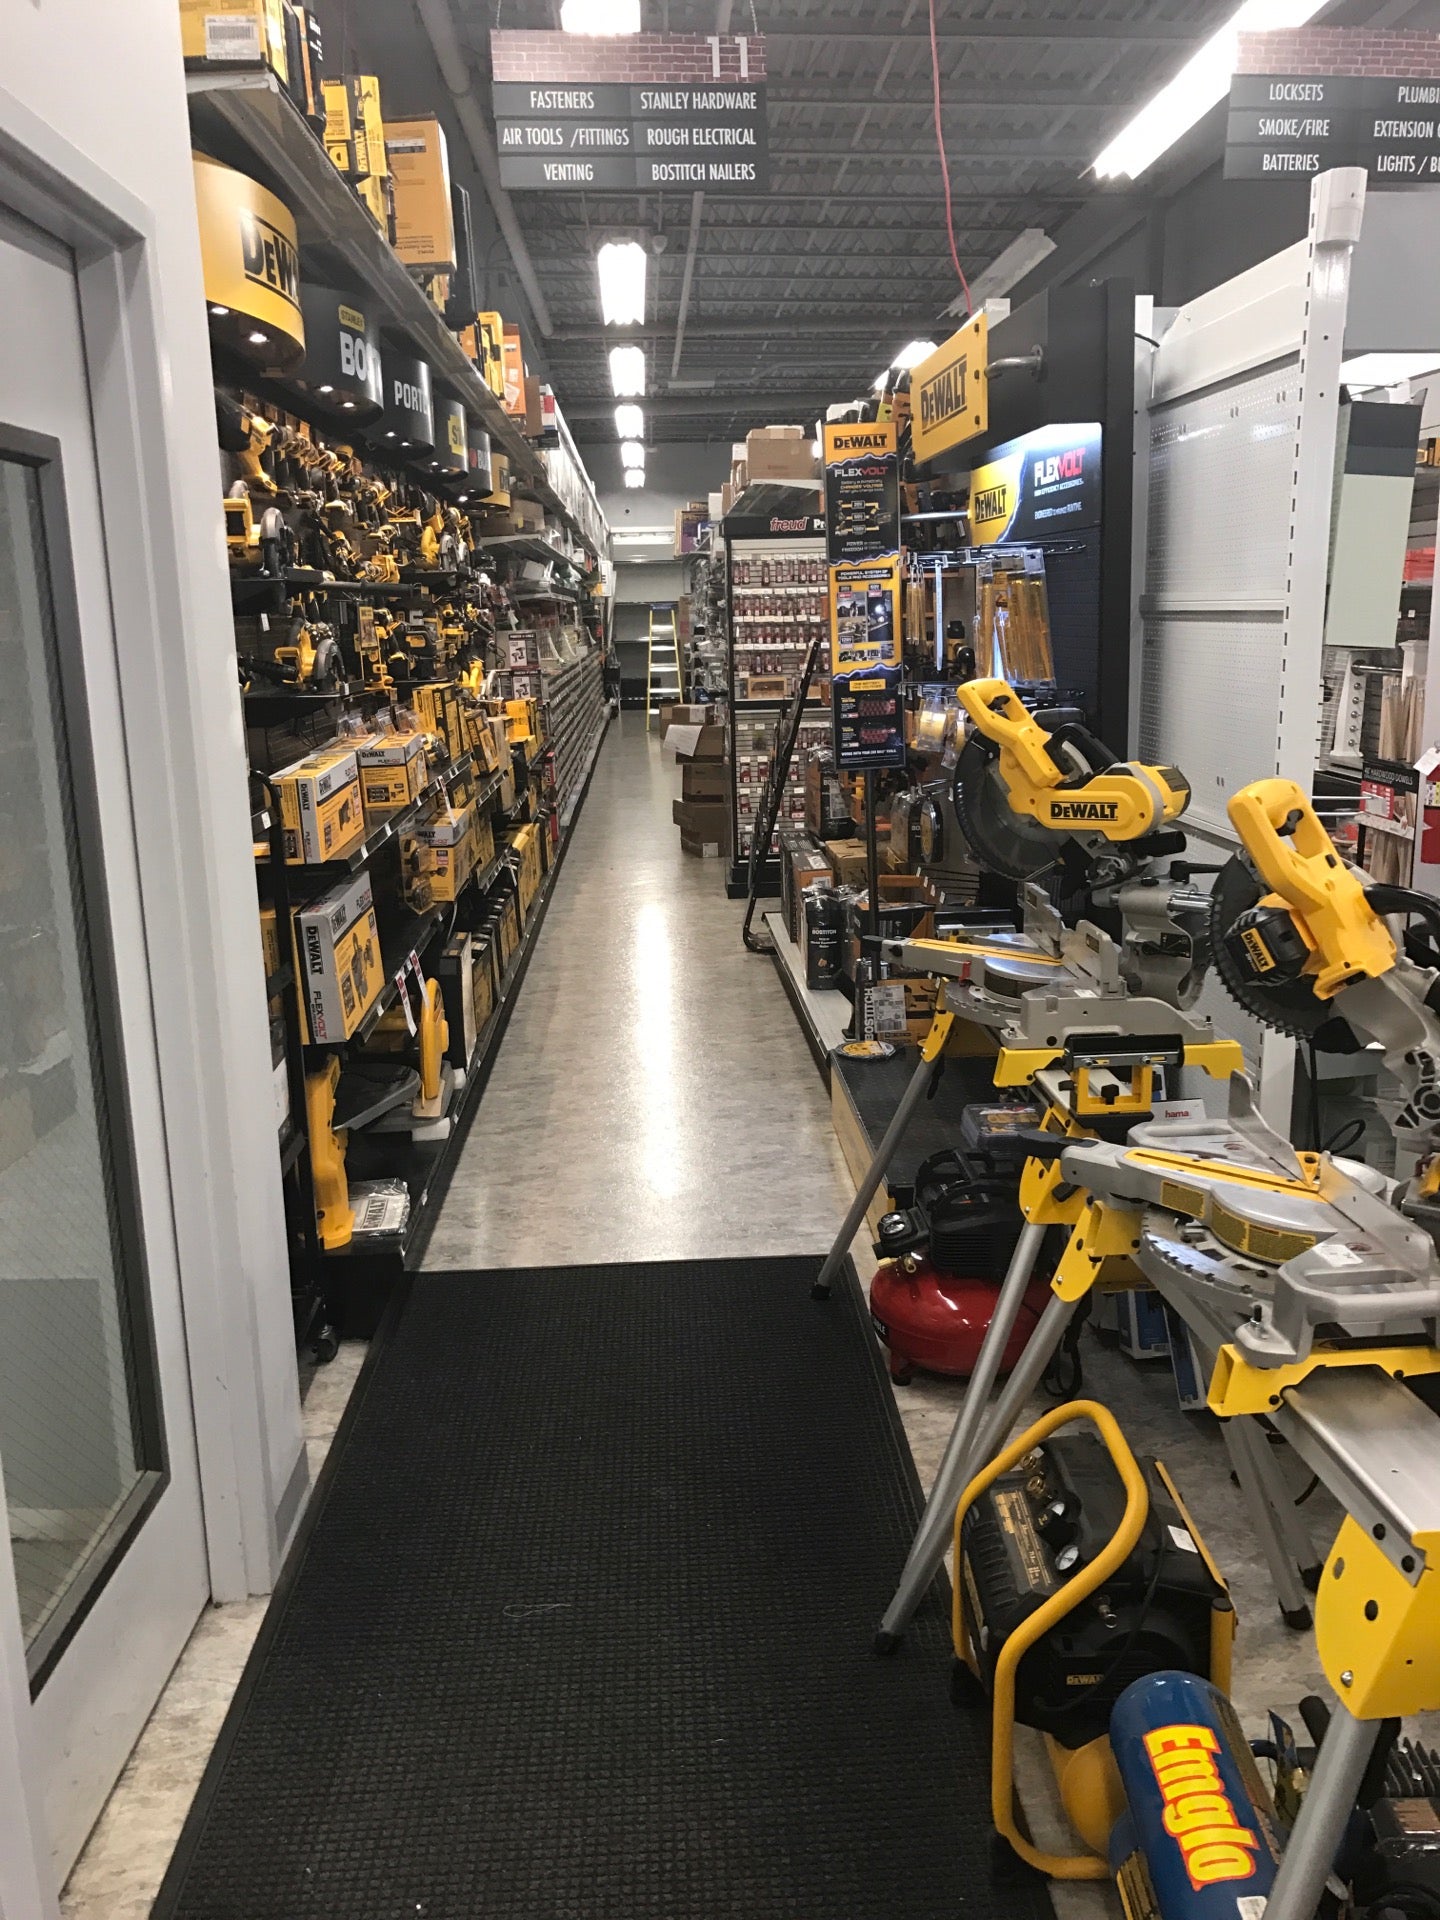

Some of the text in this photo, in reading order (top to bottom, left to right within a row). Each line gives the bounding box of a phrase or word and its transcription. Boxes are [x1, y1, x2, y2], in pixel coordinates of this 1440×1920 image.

[707, 36, 748, 78] 11
[530, 90, 595, 109] FASTENERS
[641, 91, 757, 110] STANLEY HARDWARE
[1269, 83, 1324, 101] LOCKSETS
[502, 128, 629, 148] AIR TOOLS /FITTINGS
[647, 128, 757, 146] ROUGH ELECTRICAL
[1258, 119, 1330, 138] SMOKE/FIRE
[1373, 120, 1434, 138] EXTENSION
[543, 163, 594, 181] VENTING
[652, 163, 756, 181] BOSTITCH NAILERS
[1262, 154, 1320, 171] BATTERIES
[1377, 155, 1416, 172] LIGHTS
[920, 360, 968, 432] DEWALT
[833, 435, 888, 450] DEWALT
[834, 466, 889, 478] FLEXVOLT
[1034, 447, 1086, 488] FLEXVOLT
[974, 487, 1007, 522] DEWALT
[770, 517, 807, 531] freud
[361, 750, 385, 758] DEWALT
[301, 782, 310, 812] DEWALT
[1050, 802, 1118, 820] DEWALT
[305, 925, 323, 975] DEWALT
[1244, 931, 1270, 967] DEWALT
[313, 990, 328, 1040] FLEXVOLT
[864, 988, 874, 1041] BOSTITCH
[1164, 1109, 1190, 1119] hama
[1142, 1723, 1261, 1892] Emglo
